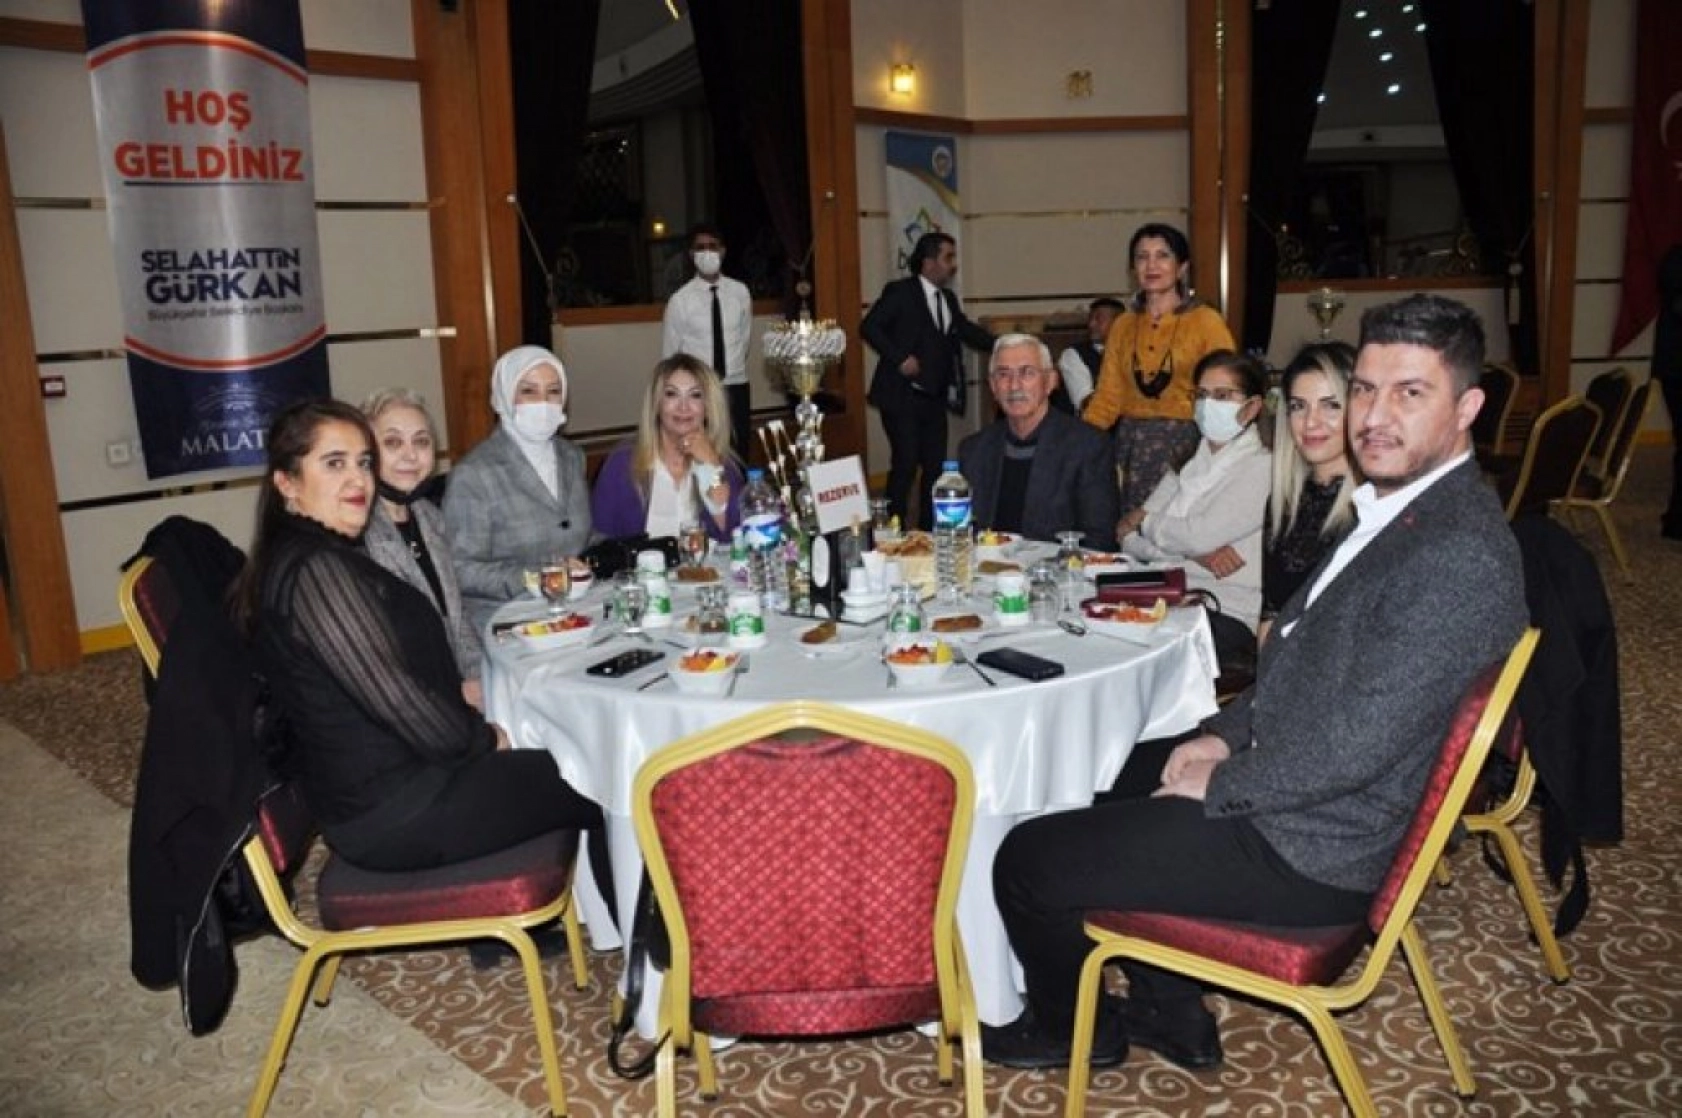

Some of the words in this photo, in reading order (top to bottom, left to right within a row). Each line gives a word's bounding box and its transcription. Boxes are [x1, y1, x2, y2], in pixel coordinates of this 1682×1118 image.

[165, 90, 251, 131] HOŞ
[114, 140, 304, 181] GELDİNİZ
[146, 271, 303, 304] GÜRKAN
[182, 429, 268, 456] MALAT
